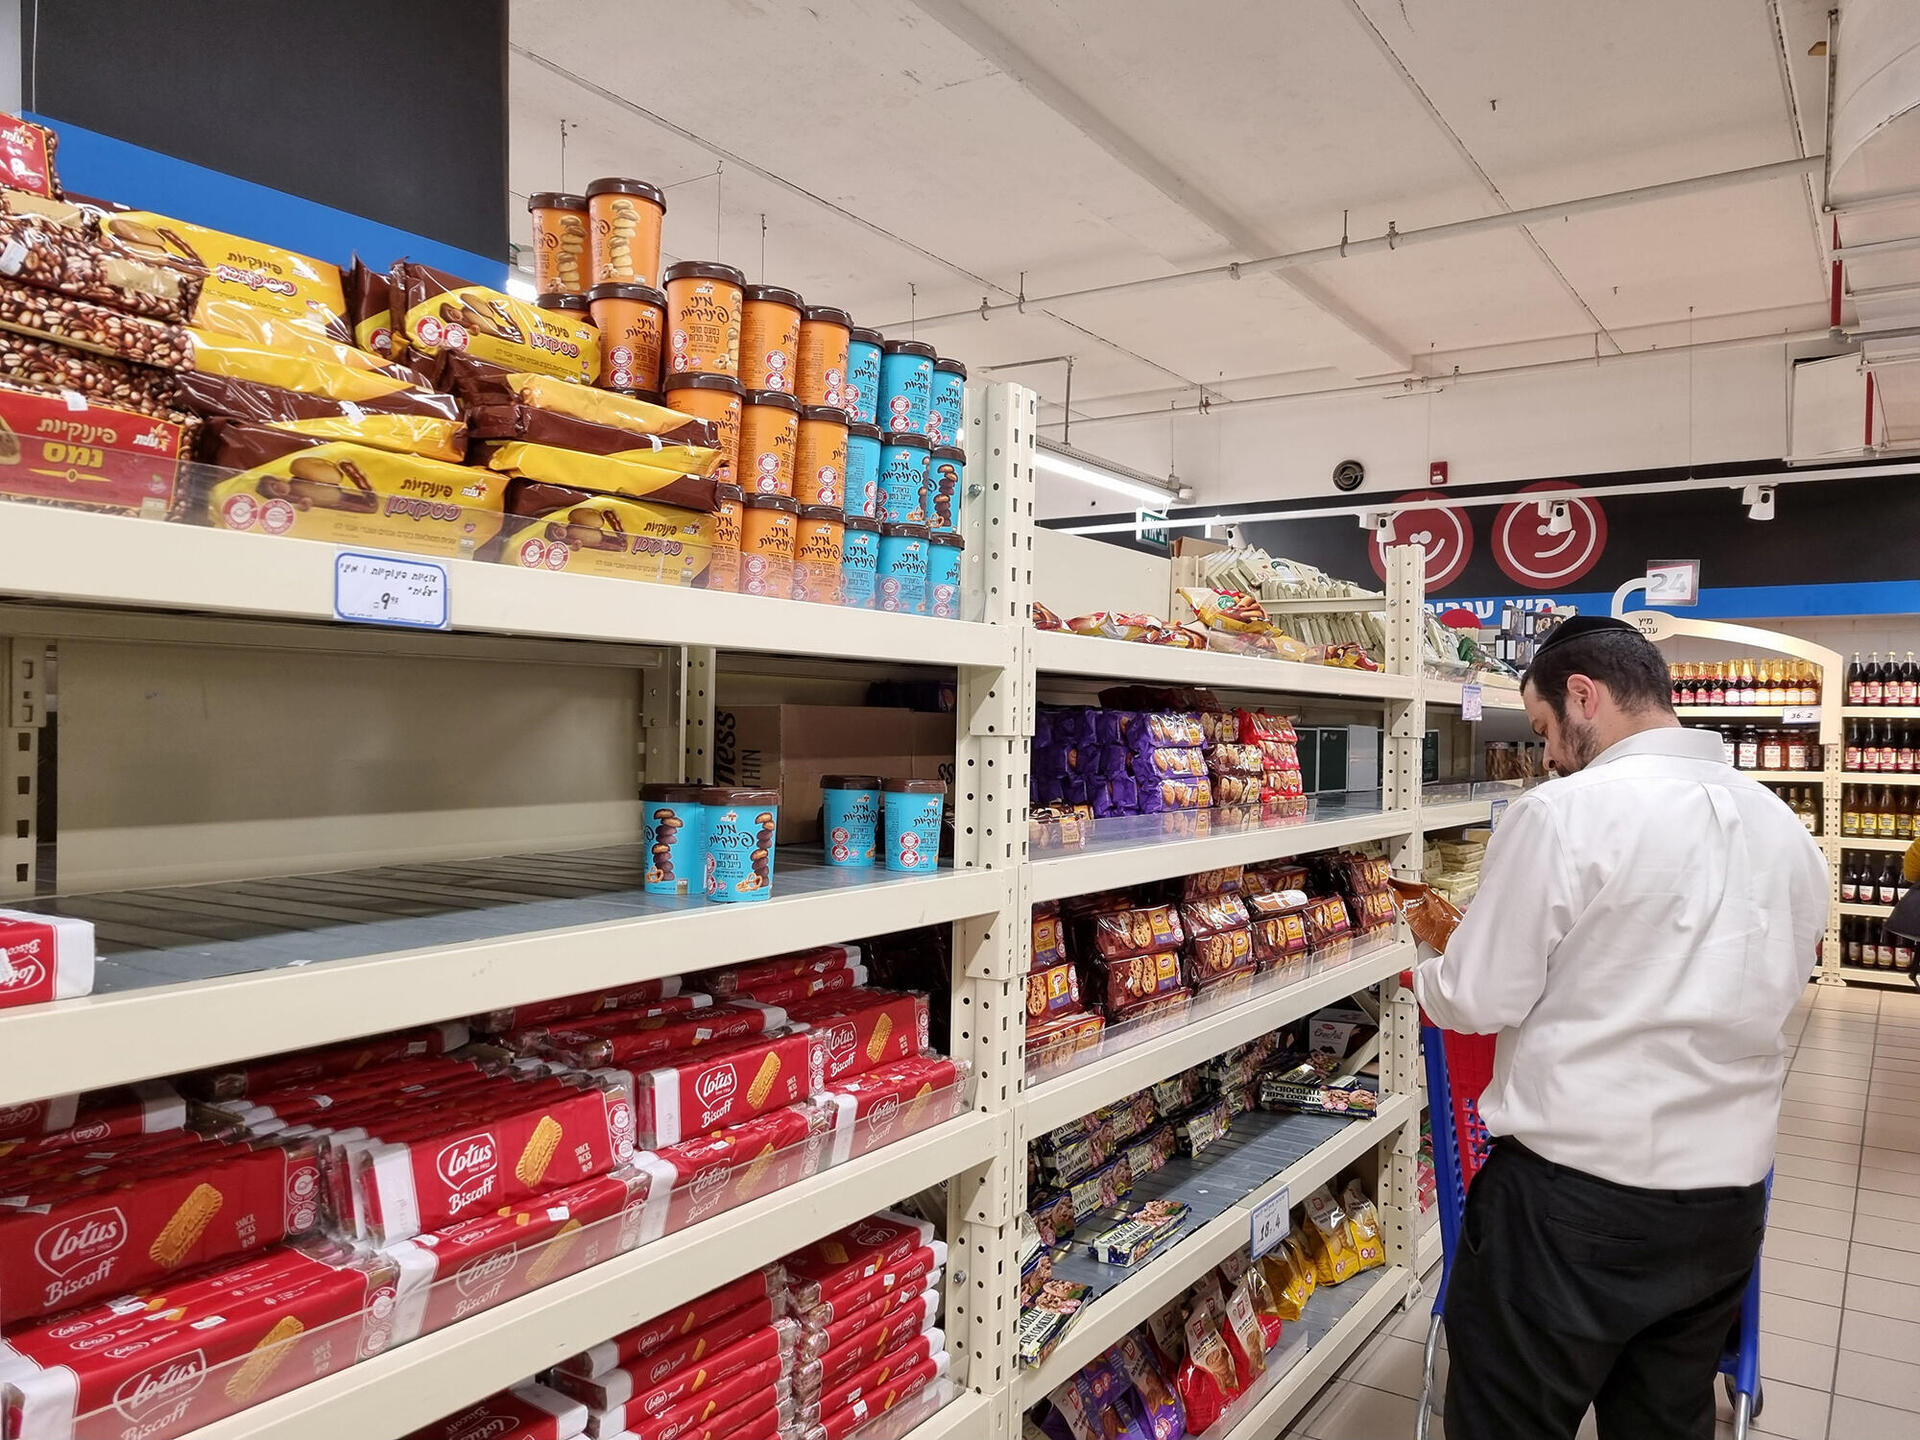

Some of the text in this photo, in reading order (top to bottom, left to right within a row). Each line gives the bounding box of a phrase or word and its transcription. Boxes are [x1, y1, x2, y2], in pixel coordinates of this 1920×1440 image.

[690, 294, 713, 308] מיני
[680, 305, 730, 324] פינוקיות
[36, 418, 118, 444] פינוקיות
[42, 441, 105, 469] נמס
[881, 468, 922, 486] פינוקיות
[400, 477, 454, 500] פינוקיות
[643, 520, 679, 537] פינוקיות
[771, 526, 790, 539] מיני
[810, 535, 831, 547] מיני
[849, 546, 868, 557] מיני
[901, 552, 920, 562] מיני
[1650, 572, 1688, 593] 24
[1638, 617, 1653, 626] מיץ
[852, 803, 869, 813] מיני
[709, 831, 755, 849] פינוקיות
[716, 824, 737, 835] מיני
[829, 1028, 855, 1051] Lotus
[830, 1051, 856, 1078] Biscoff
[702, 1071, 733, 1099] Lotus
[1274, 1085, 1322, 1096] CHOCOLATE
[701, 1097, 734, 1129] Biscoff
[447, 1142, 493, 1178] Lotus
[447, 1174, 497, 1216] Biscoff
[49, 1220, 118, 1262] Lotus
[43, 1255, 120, 1307] Biscoff
[131, 1361, 198, 1410] Lotus
[120, 1396, 196, 1440] Biscoff
